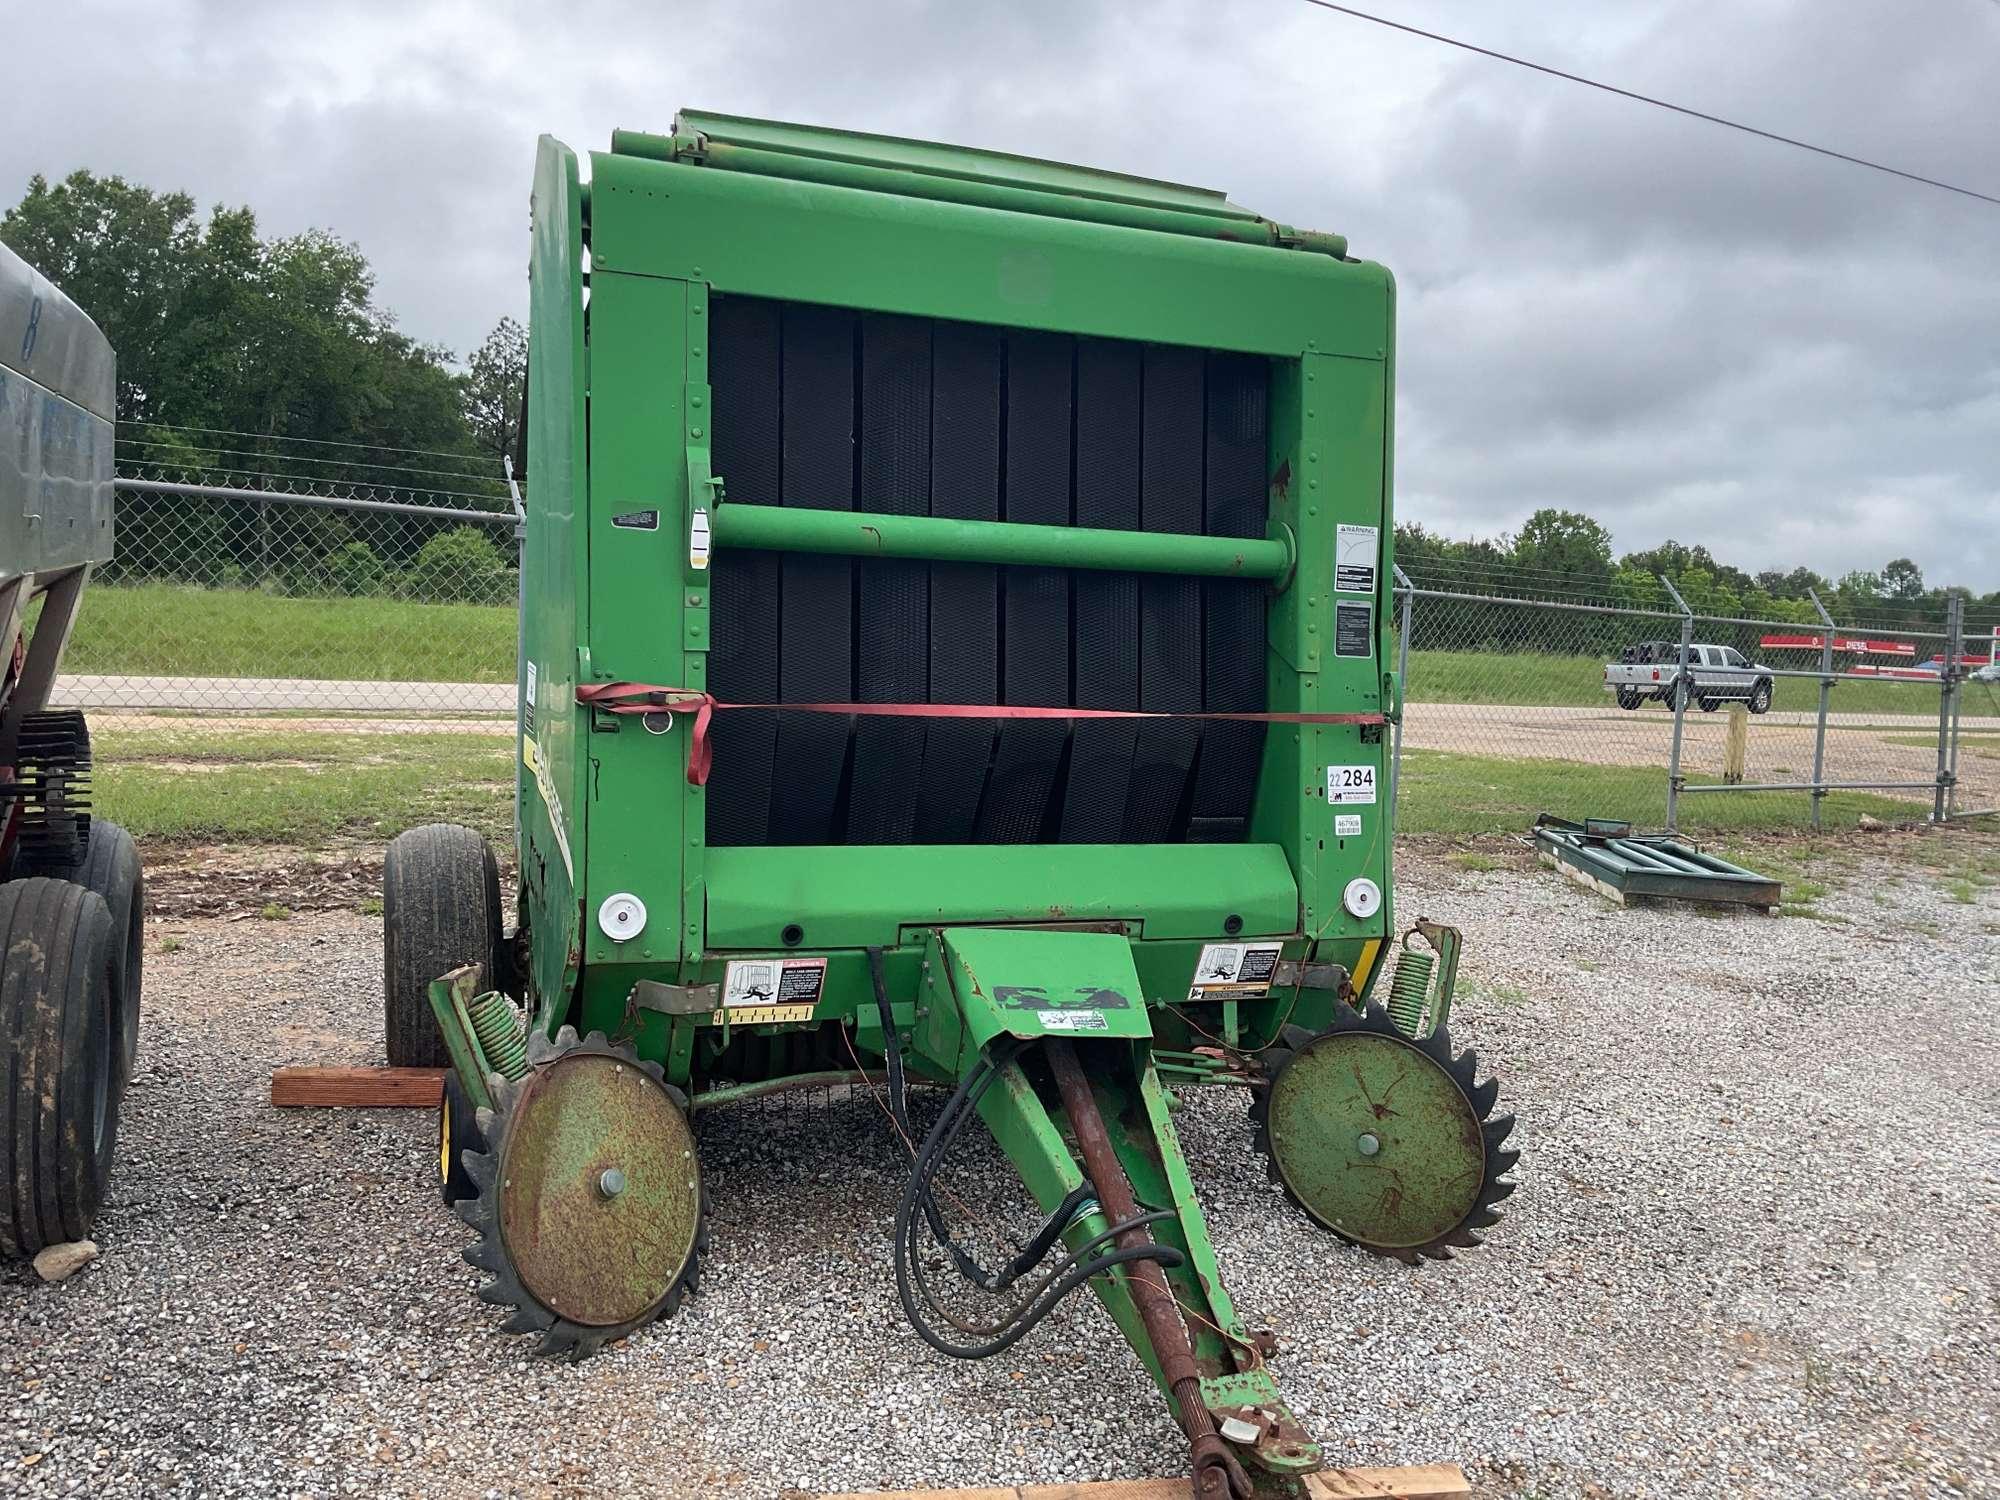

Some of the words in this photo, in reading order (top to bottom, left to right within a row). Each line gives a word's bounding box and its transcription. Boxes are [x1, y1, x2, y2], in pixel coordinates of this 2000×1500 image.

[1346, 526, 1375, 534] WARNING
[1846, 641, 1868, 650] DIESEL
[1330, 774, 1340, 787] 22
[1343, 769, 1373, 787] 284
